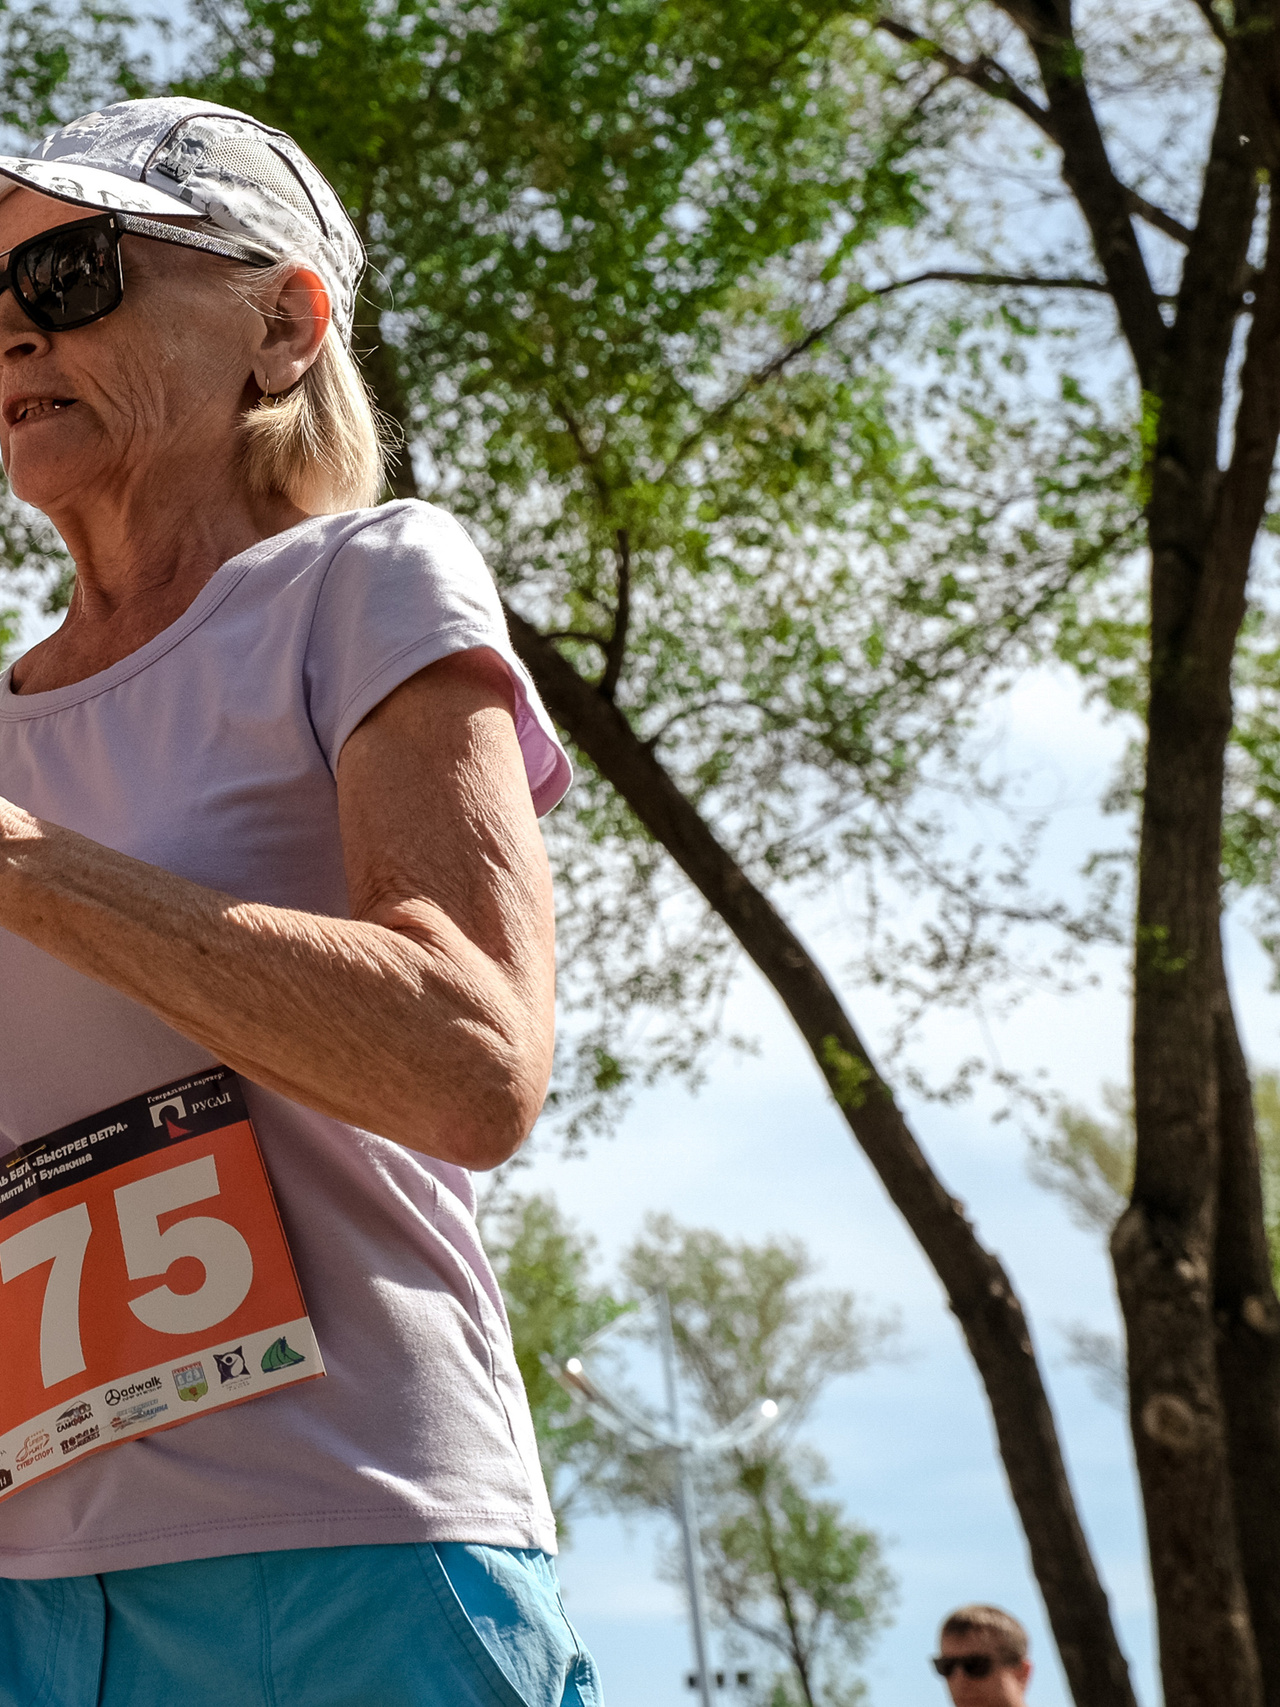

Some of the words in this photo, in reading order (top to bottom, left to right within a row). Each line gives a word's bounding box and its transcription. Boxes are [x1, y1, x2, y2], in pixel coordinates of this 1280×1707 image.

[191, 1092, 232, 1114] РУСАЛ
[10, 1162, 31, 1182] БЕГА
[32, 1137, 89, 1167] «БЫСТРЕЕ
[89, 1122, 128, 1145] ВЕТРА»
[39, 1152, 93, 1181] Булакина
